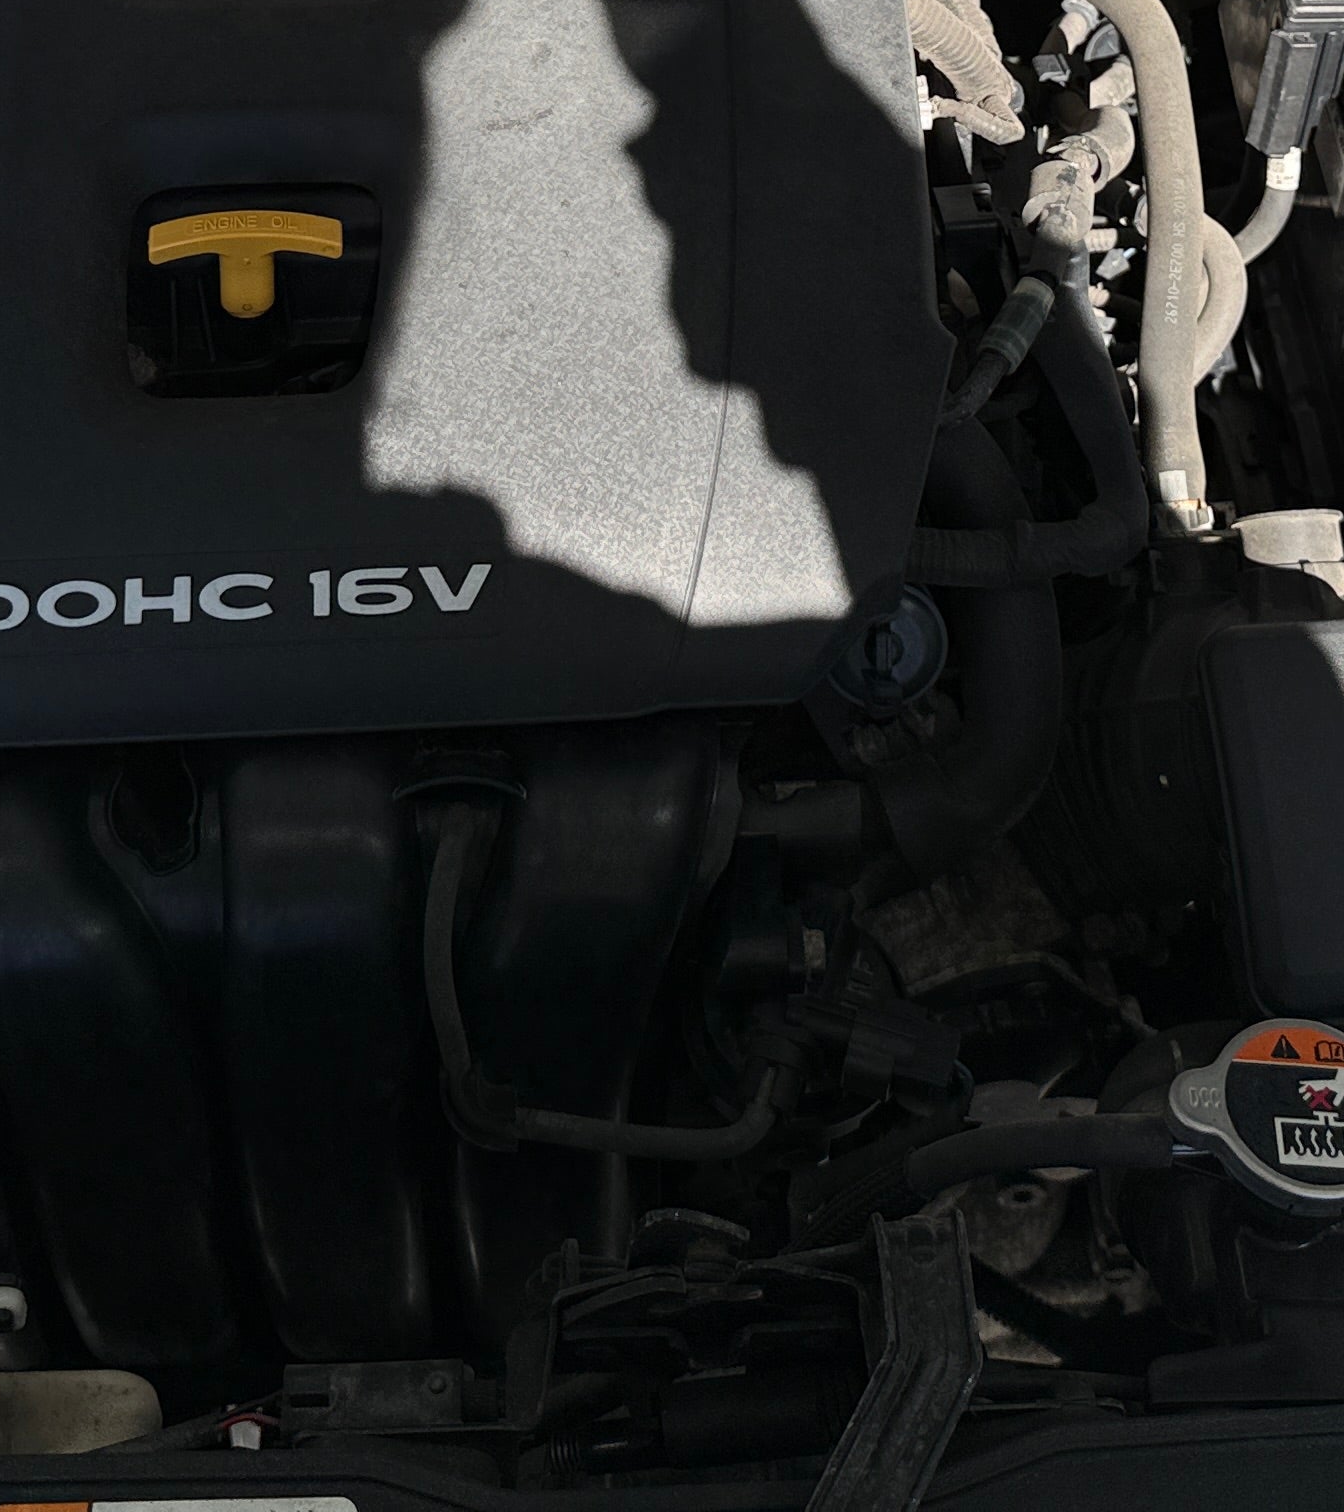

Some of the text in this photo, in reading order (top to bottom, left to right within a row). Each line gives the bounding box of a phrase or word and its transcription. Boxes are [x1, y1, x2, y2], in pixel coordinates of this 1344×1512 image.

[191, 214, 298, 233] ENGINE OIL
[309, 563, 493, 618] 16V
